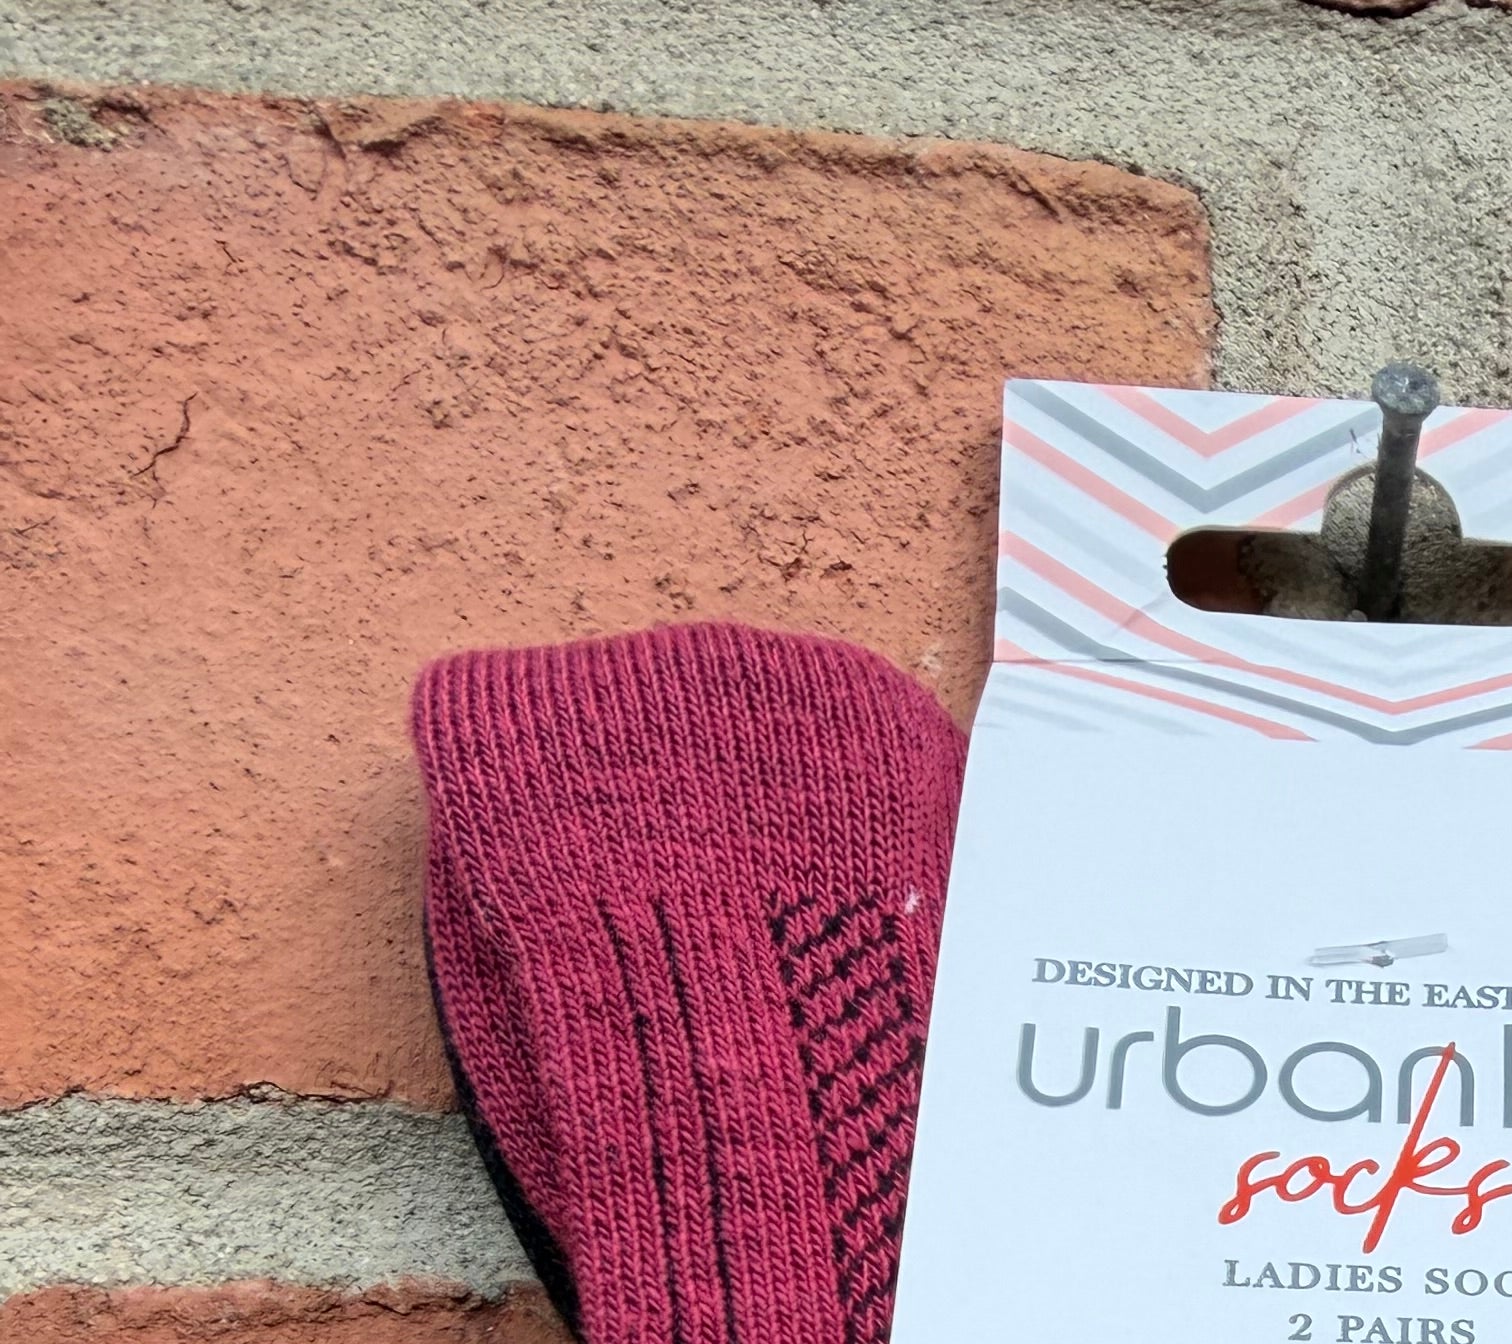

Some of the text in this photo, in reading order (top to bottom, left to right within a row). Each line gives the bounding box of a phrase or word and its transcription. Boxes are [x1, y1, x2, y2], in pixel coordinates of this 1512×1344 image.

[1032, 958, 1254, 997] DESIGNED
[1265, 974, 1311, 1002] IN
[1325, 979, 1411, 1006] THE
[1222, 1259, 1403, 1294] LADIES
[1287, 1313, 1313, 1341] 2
